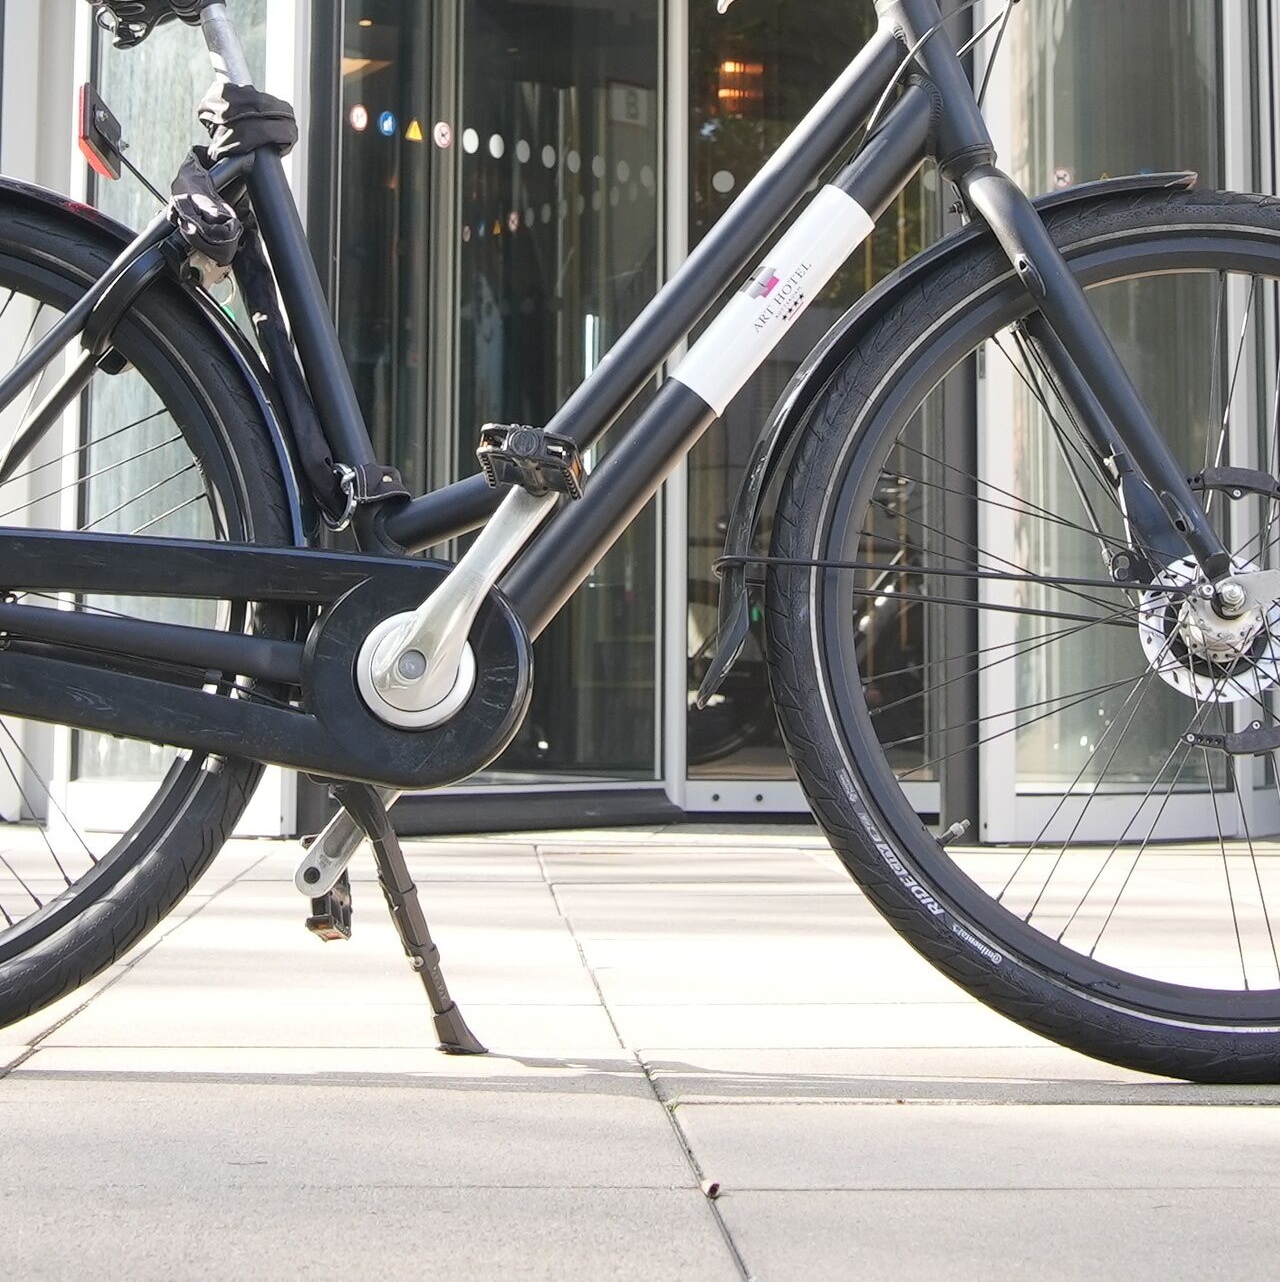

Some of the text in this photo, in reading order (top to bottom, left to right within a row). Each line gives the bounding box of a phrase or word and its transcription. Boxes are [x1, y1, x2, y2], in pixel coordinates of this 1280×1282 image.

[753, 262, 812, 333] ART HOTEL
[899, 874, 945, 916] RIDE
